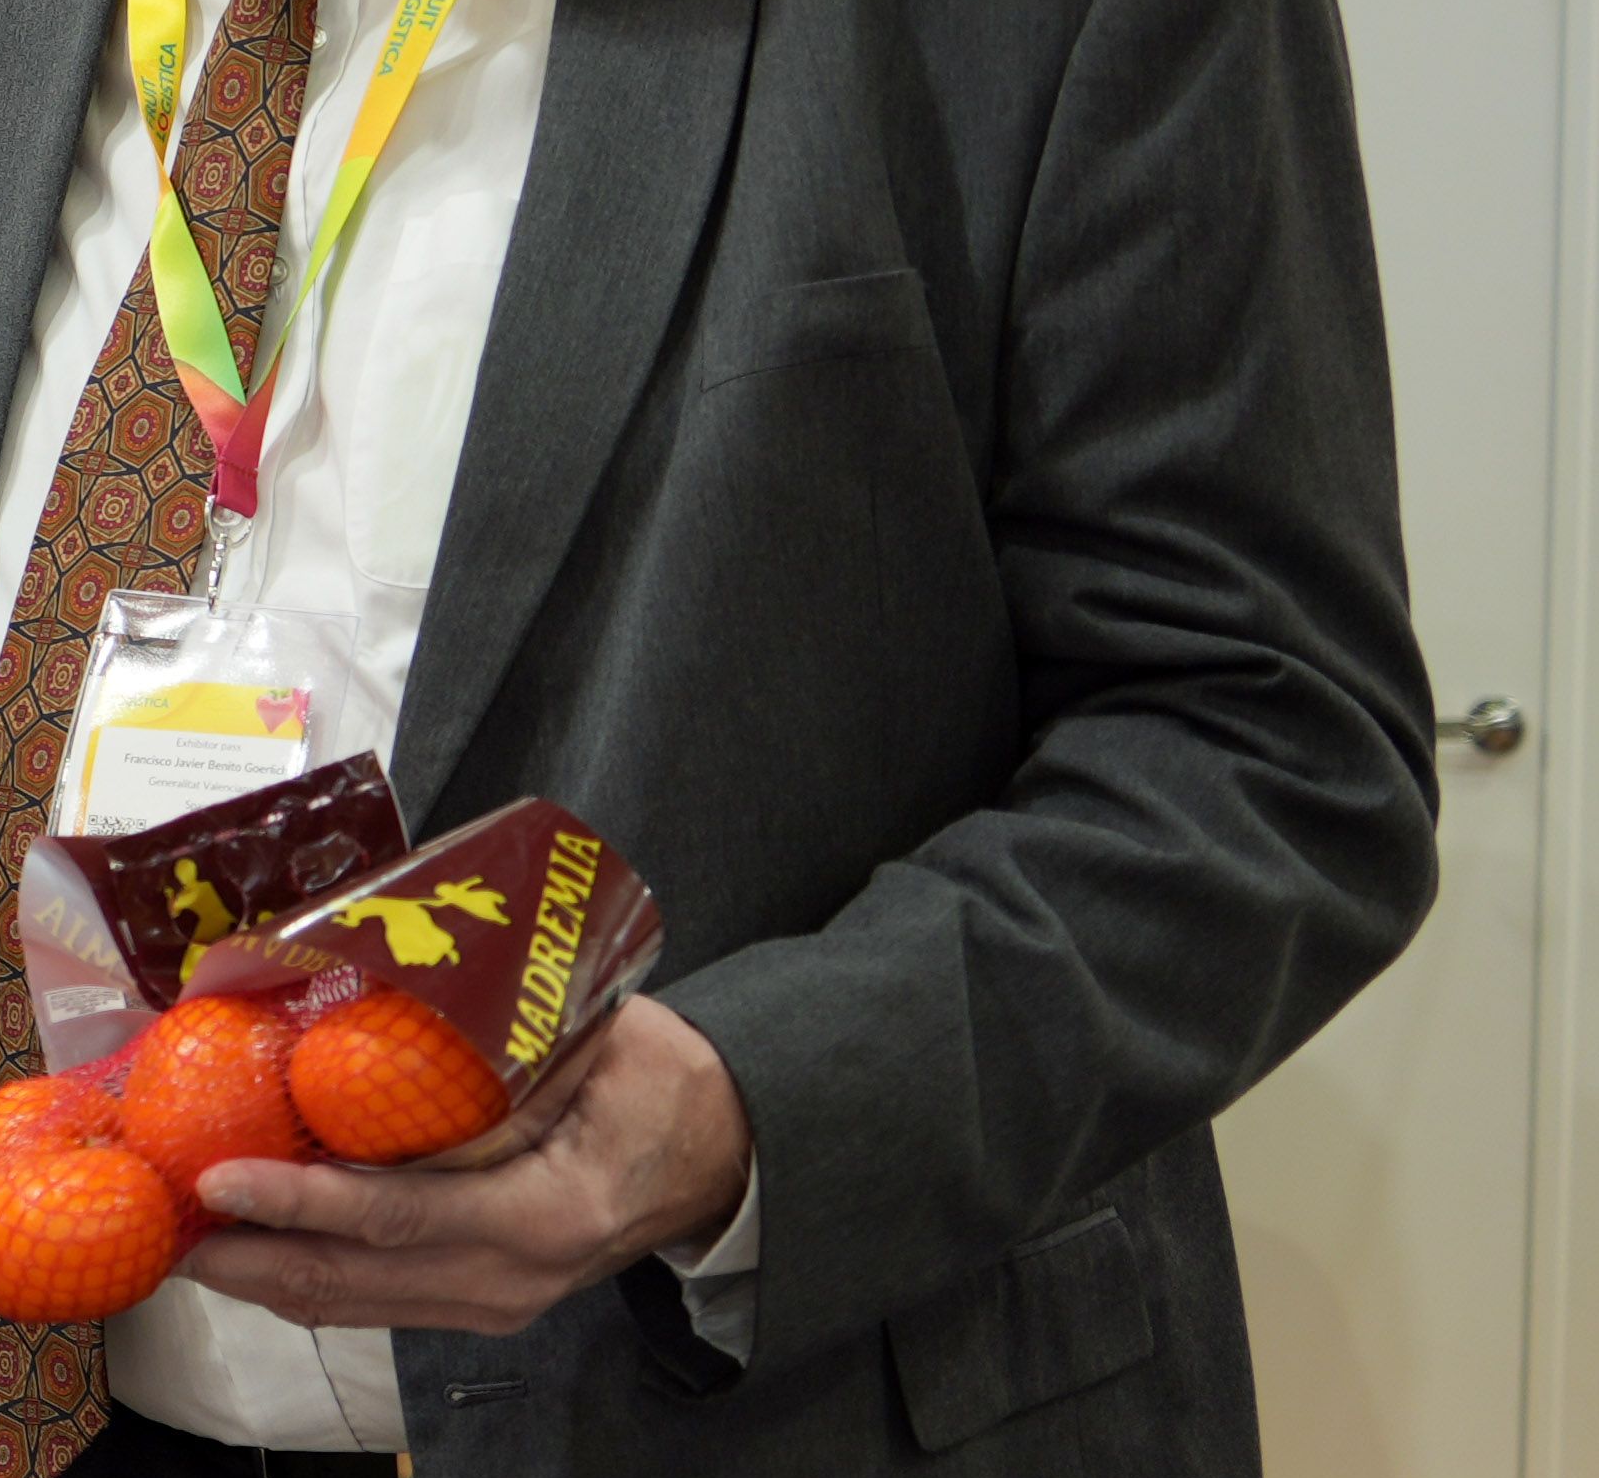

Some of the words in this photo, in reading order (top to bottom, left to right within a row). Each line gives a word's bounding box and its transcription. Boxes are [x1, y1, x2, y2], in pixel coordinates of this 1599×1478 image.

[155, 43, 177, 143] LOGISTICA
[175, 737, 219, 751] Exhibitor
[123, 753, 173, 767] Francisco
[174, 756, 206, 770] Javier
[207, 759, 243, 773] Benito
[148, 776, 201, 791] Generalitat
[505, 829, 603, 1081] MADREMIA
